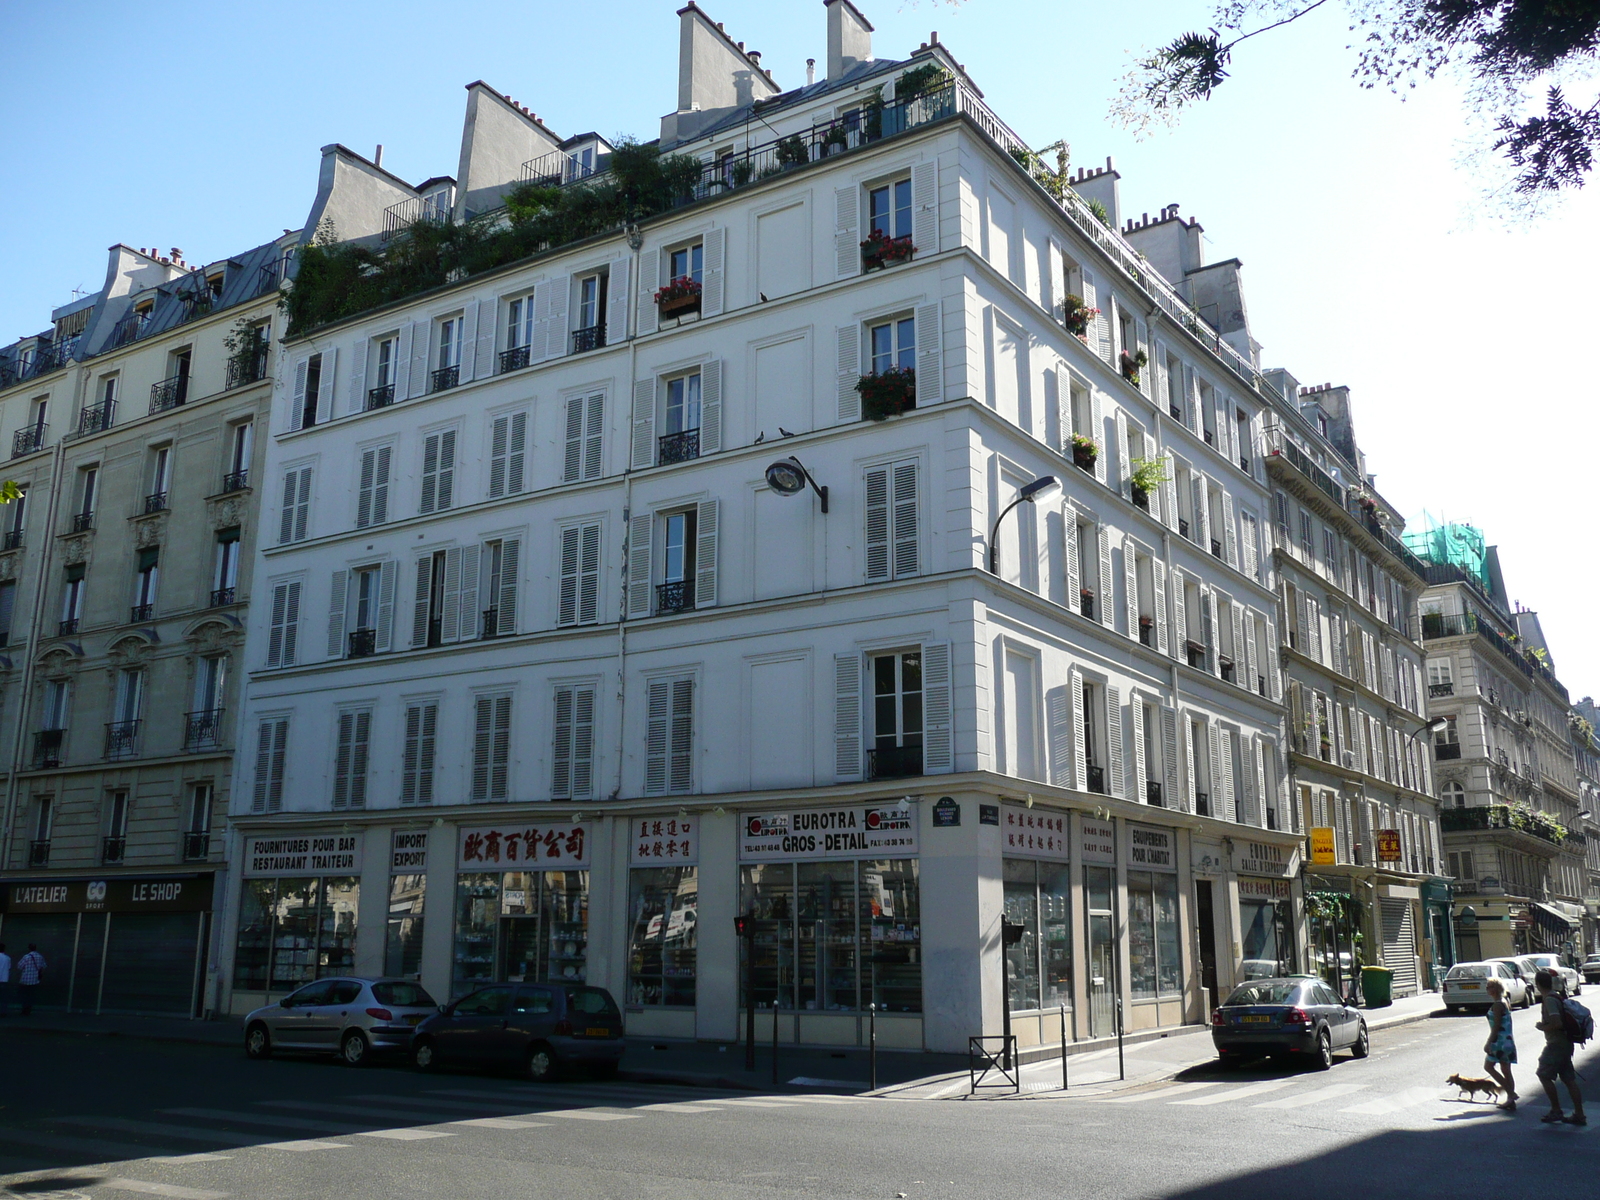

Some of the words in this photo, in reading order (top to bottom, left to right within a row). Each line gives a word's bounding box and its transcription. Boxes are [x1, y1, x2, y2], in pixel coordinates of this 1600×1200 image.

[639, 819, 691, 838] 直接進口
[793, 811, 856, 831] EUROTRA
[254, 839, 309, 855] FOURNITURES
[312, 838, 335, 852] POUR
[338, 837, 356, 851] BAR
[395, 834, 427, 849] IMPORT
[463, 827, 585, 863] 歐商百貨公司
[782, 835, 816, 853] GROS
[825, 832, 868, 851] DETAIL
[1132, 829, 1168, 848] EQUIPEMENTS
[638, 839, 690, 858] 批發零售
[1132, 847, 1146, 863] POUR
[1147, 847, 1170, 865] L'HABITAT
[1249, 843, 1282, 862] EUROTRA
[252, 856, 308, 871] RESTAURANT
[311, 854, 354, 869] TRAITEUR
[393, 851, 426, 867] EXPORT
[1241, 858, 1257, 872] SALLE
[15, 886, 68, 903] L'ATELIER
[132, 884, 148, 902] LE
[149, 883, 182, 901] SHOP
[86, 881, 107, 900] GO
